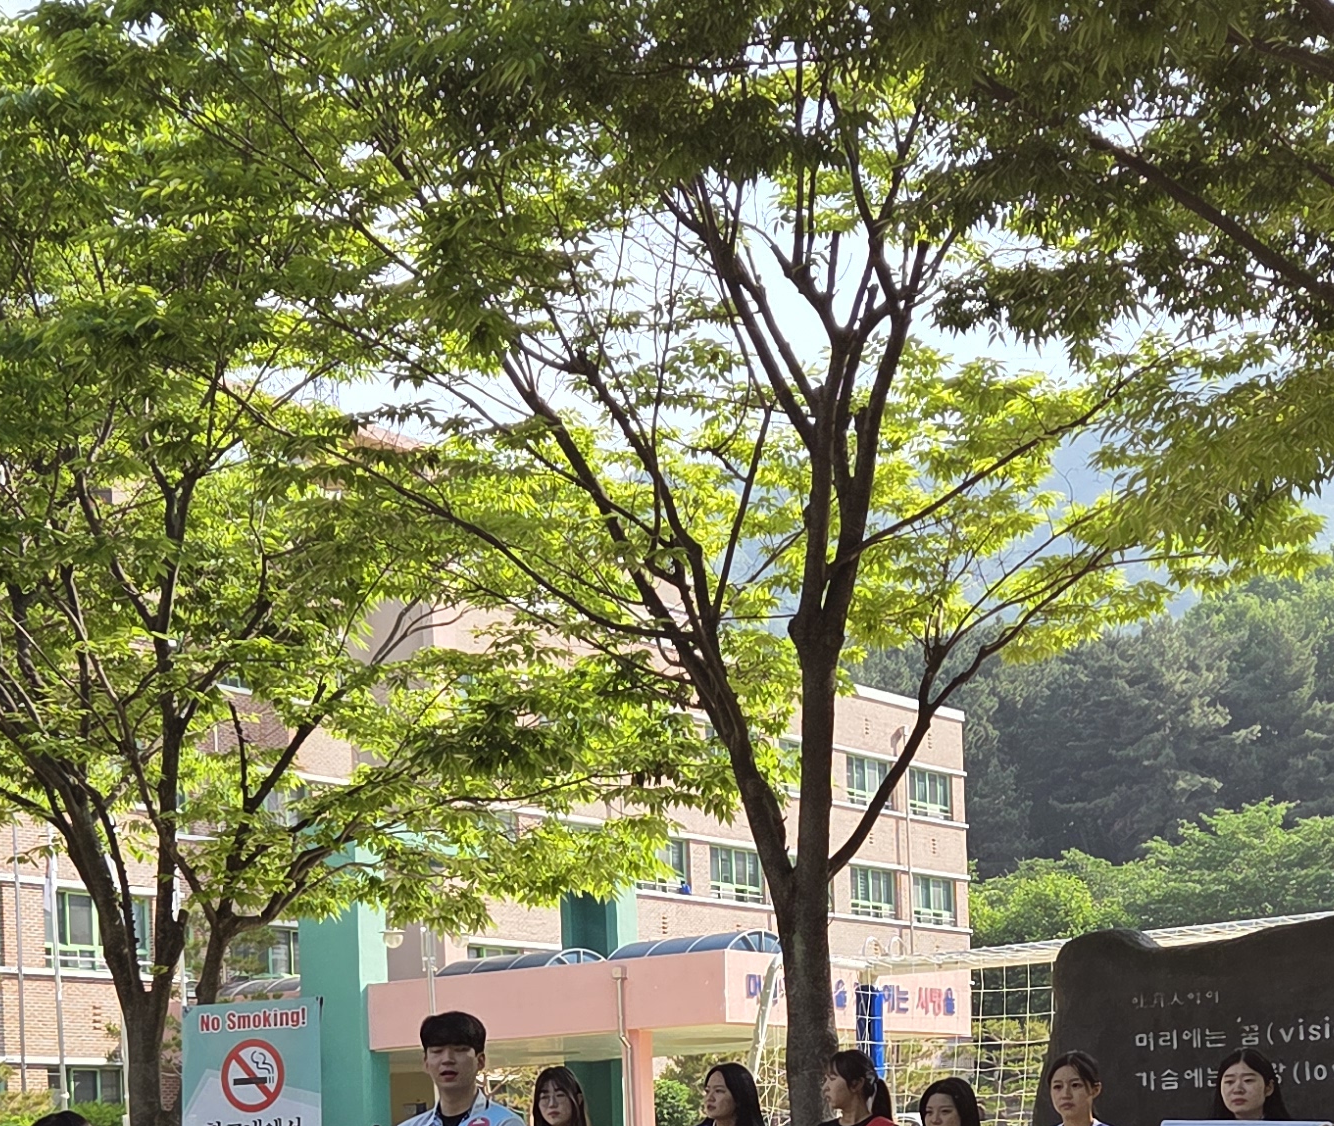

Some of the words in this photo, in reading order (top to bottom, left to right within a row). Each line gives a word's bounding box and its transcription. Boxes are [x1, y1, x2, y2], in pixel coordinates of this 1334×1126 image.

[200, 1013, 222, 1032] No
[227, 1007, 307, 1031] Smoking!
[1134, 1027, 1227, 1051] 머리에는
